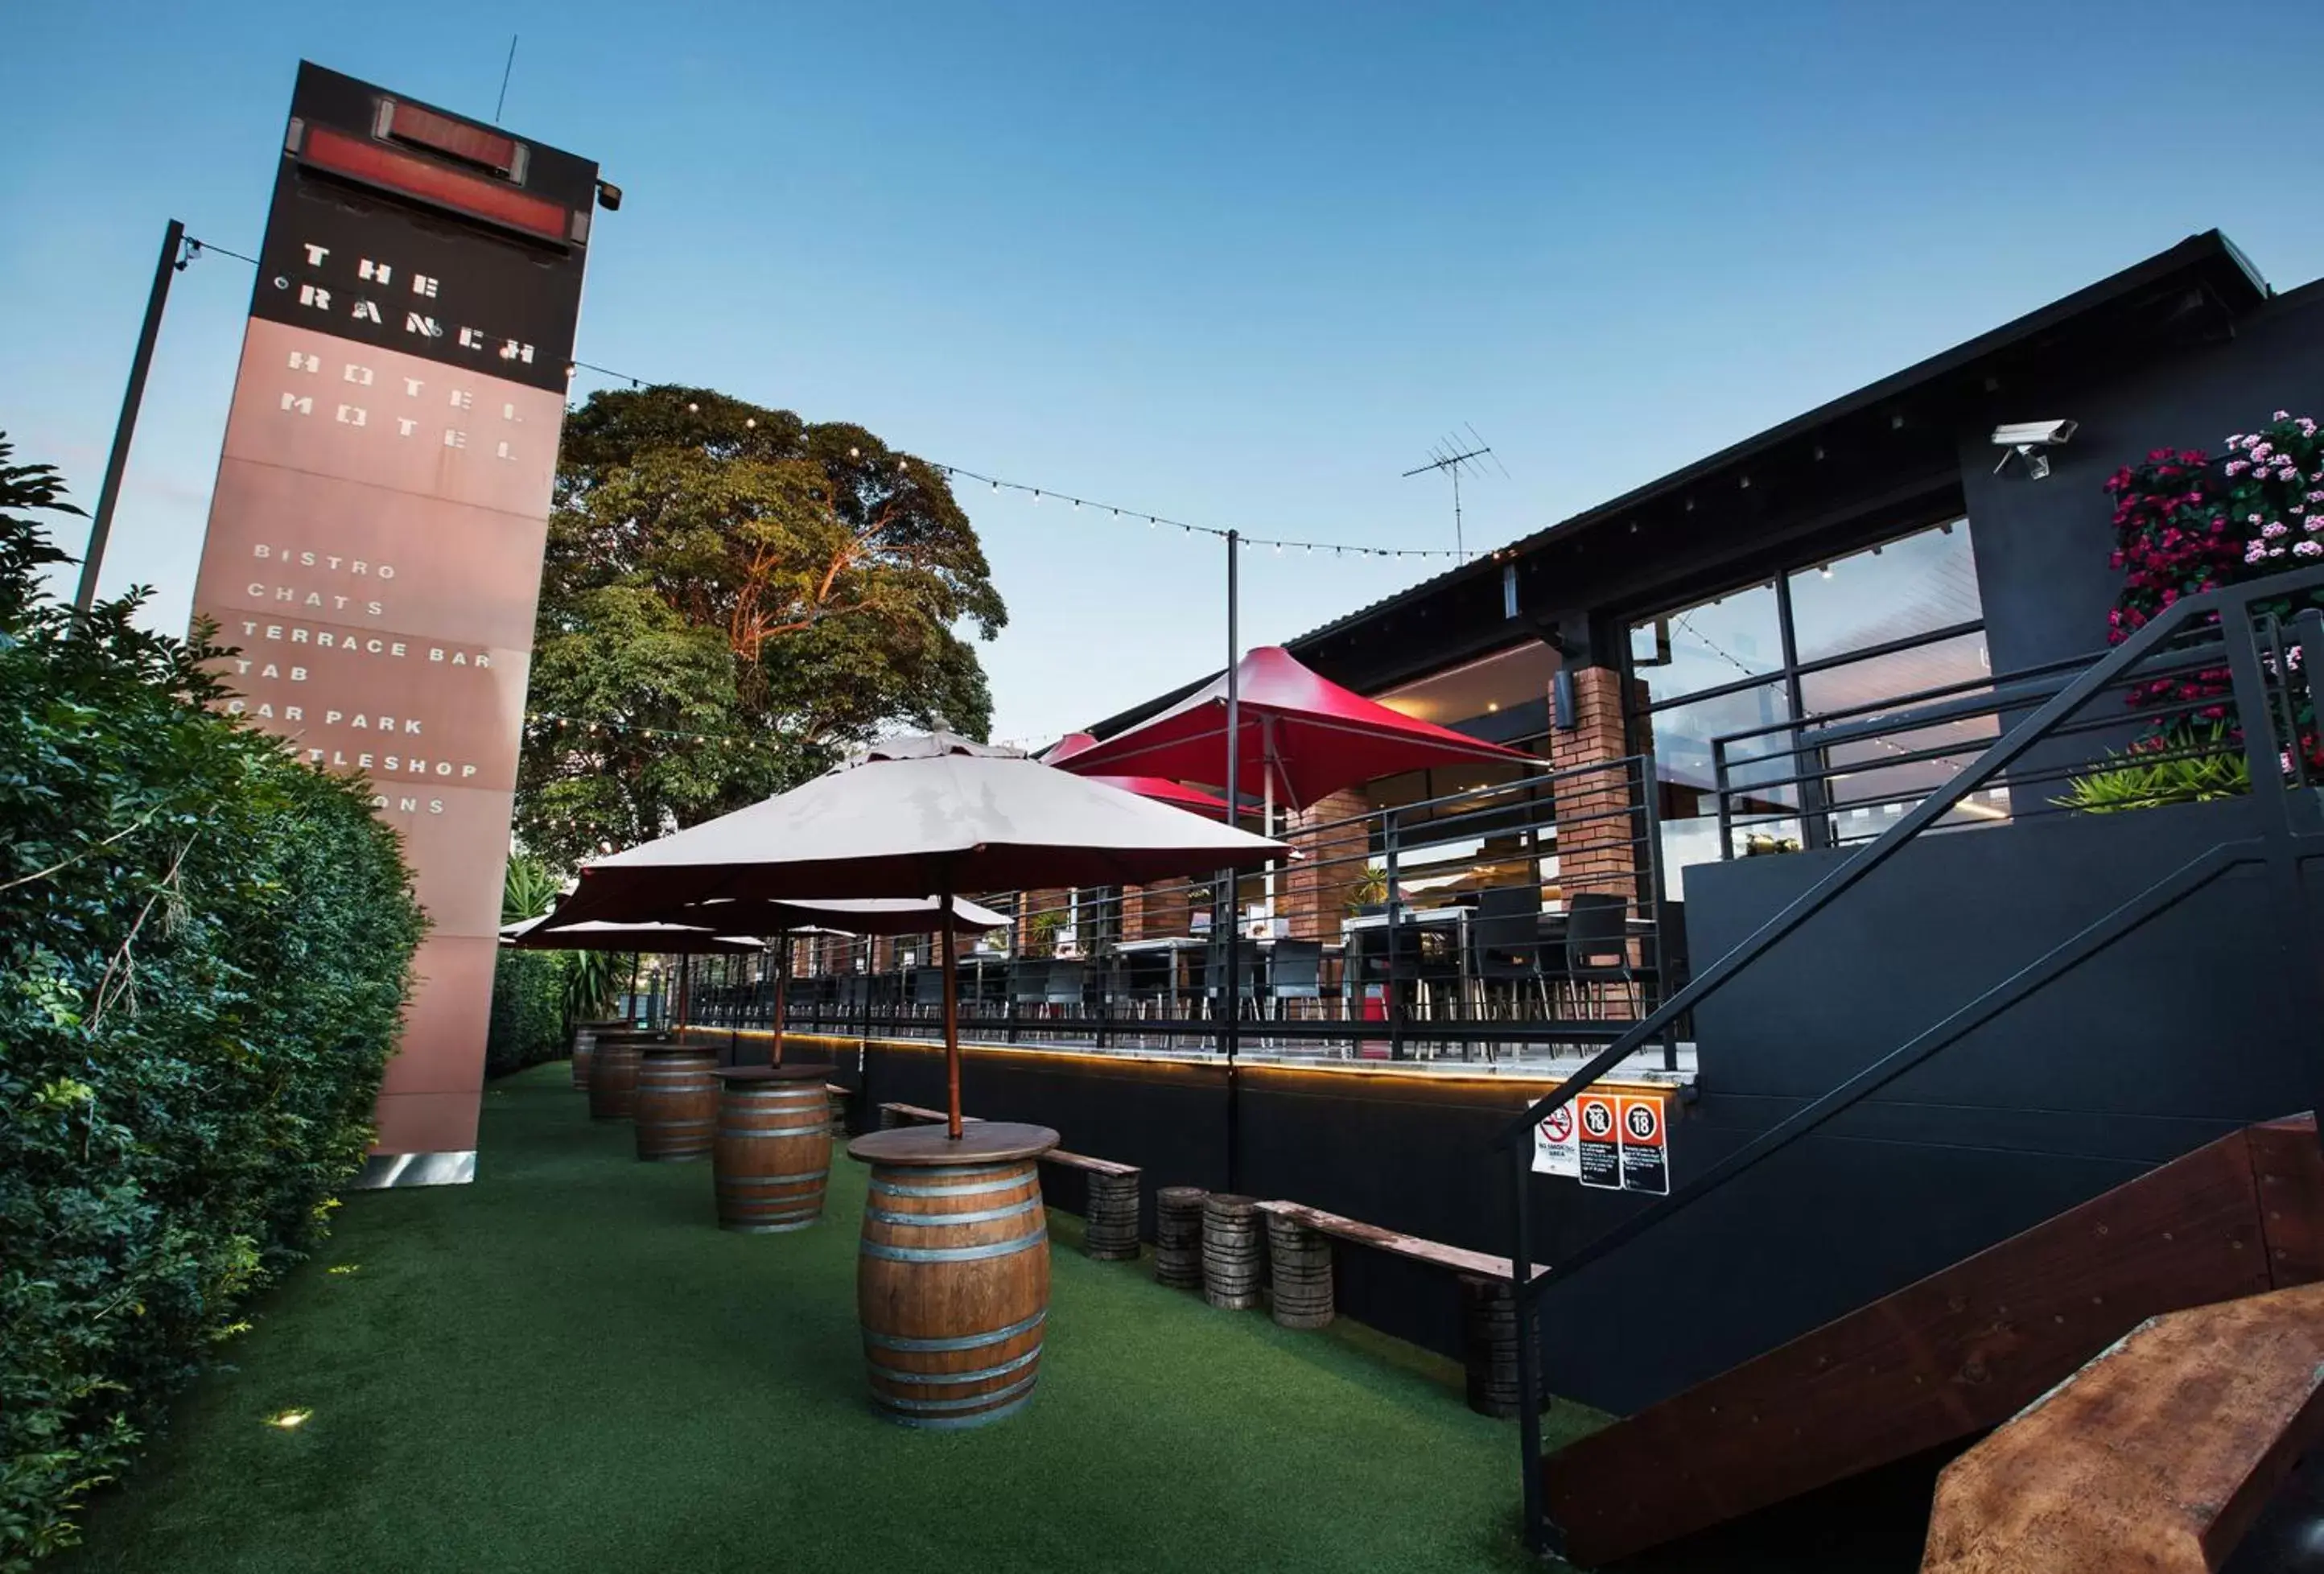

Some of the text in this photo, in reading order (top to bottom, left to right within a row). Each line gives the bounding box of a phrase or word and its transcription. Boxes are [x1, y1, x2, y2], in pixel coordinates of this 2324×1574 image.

[304, 243, 439, 299] THE
[299, 284, 535, 364] RANCH
[287, 351, 523, 422] HOTEL
[280, 392, 517, 460] MOTEL
[253, 544, 395, 579] BISTRO
[247, 583, 383, 616] CHATS
[242, 621, 492, 669] TERRACE BAR
[236, 659, 308, 681] TAB
[228, 700, 422, 734] CAR PARK
[282, 747, 477, 777] TLESHOP
[372, 795, 444, 814] ONS
[1633, 1116, 1649, 1133] 18
